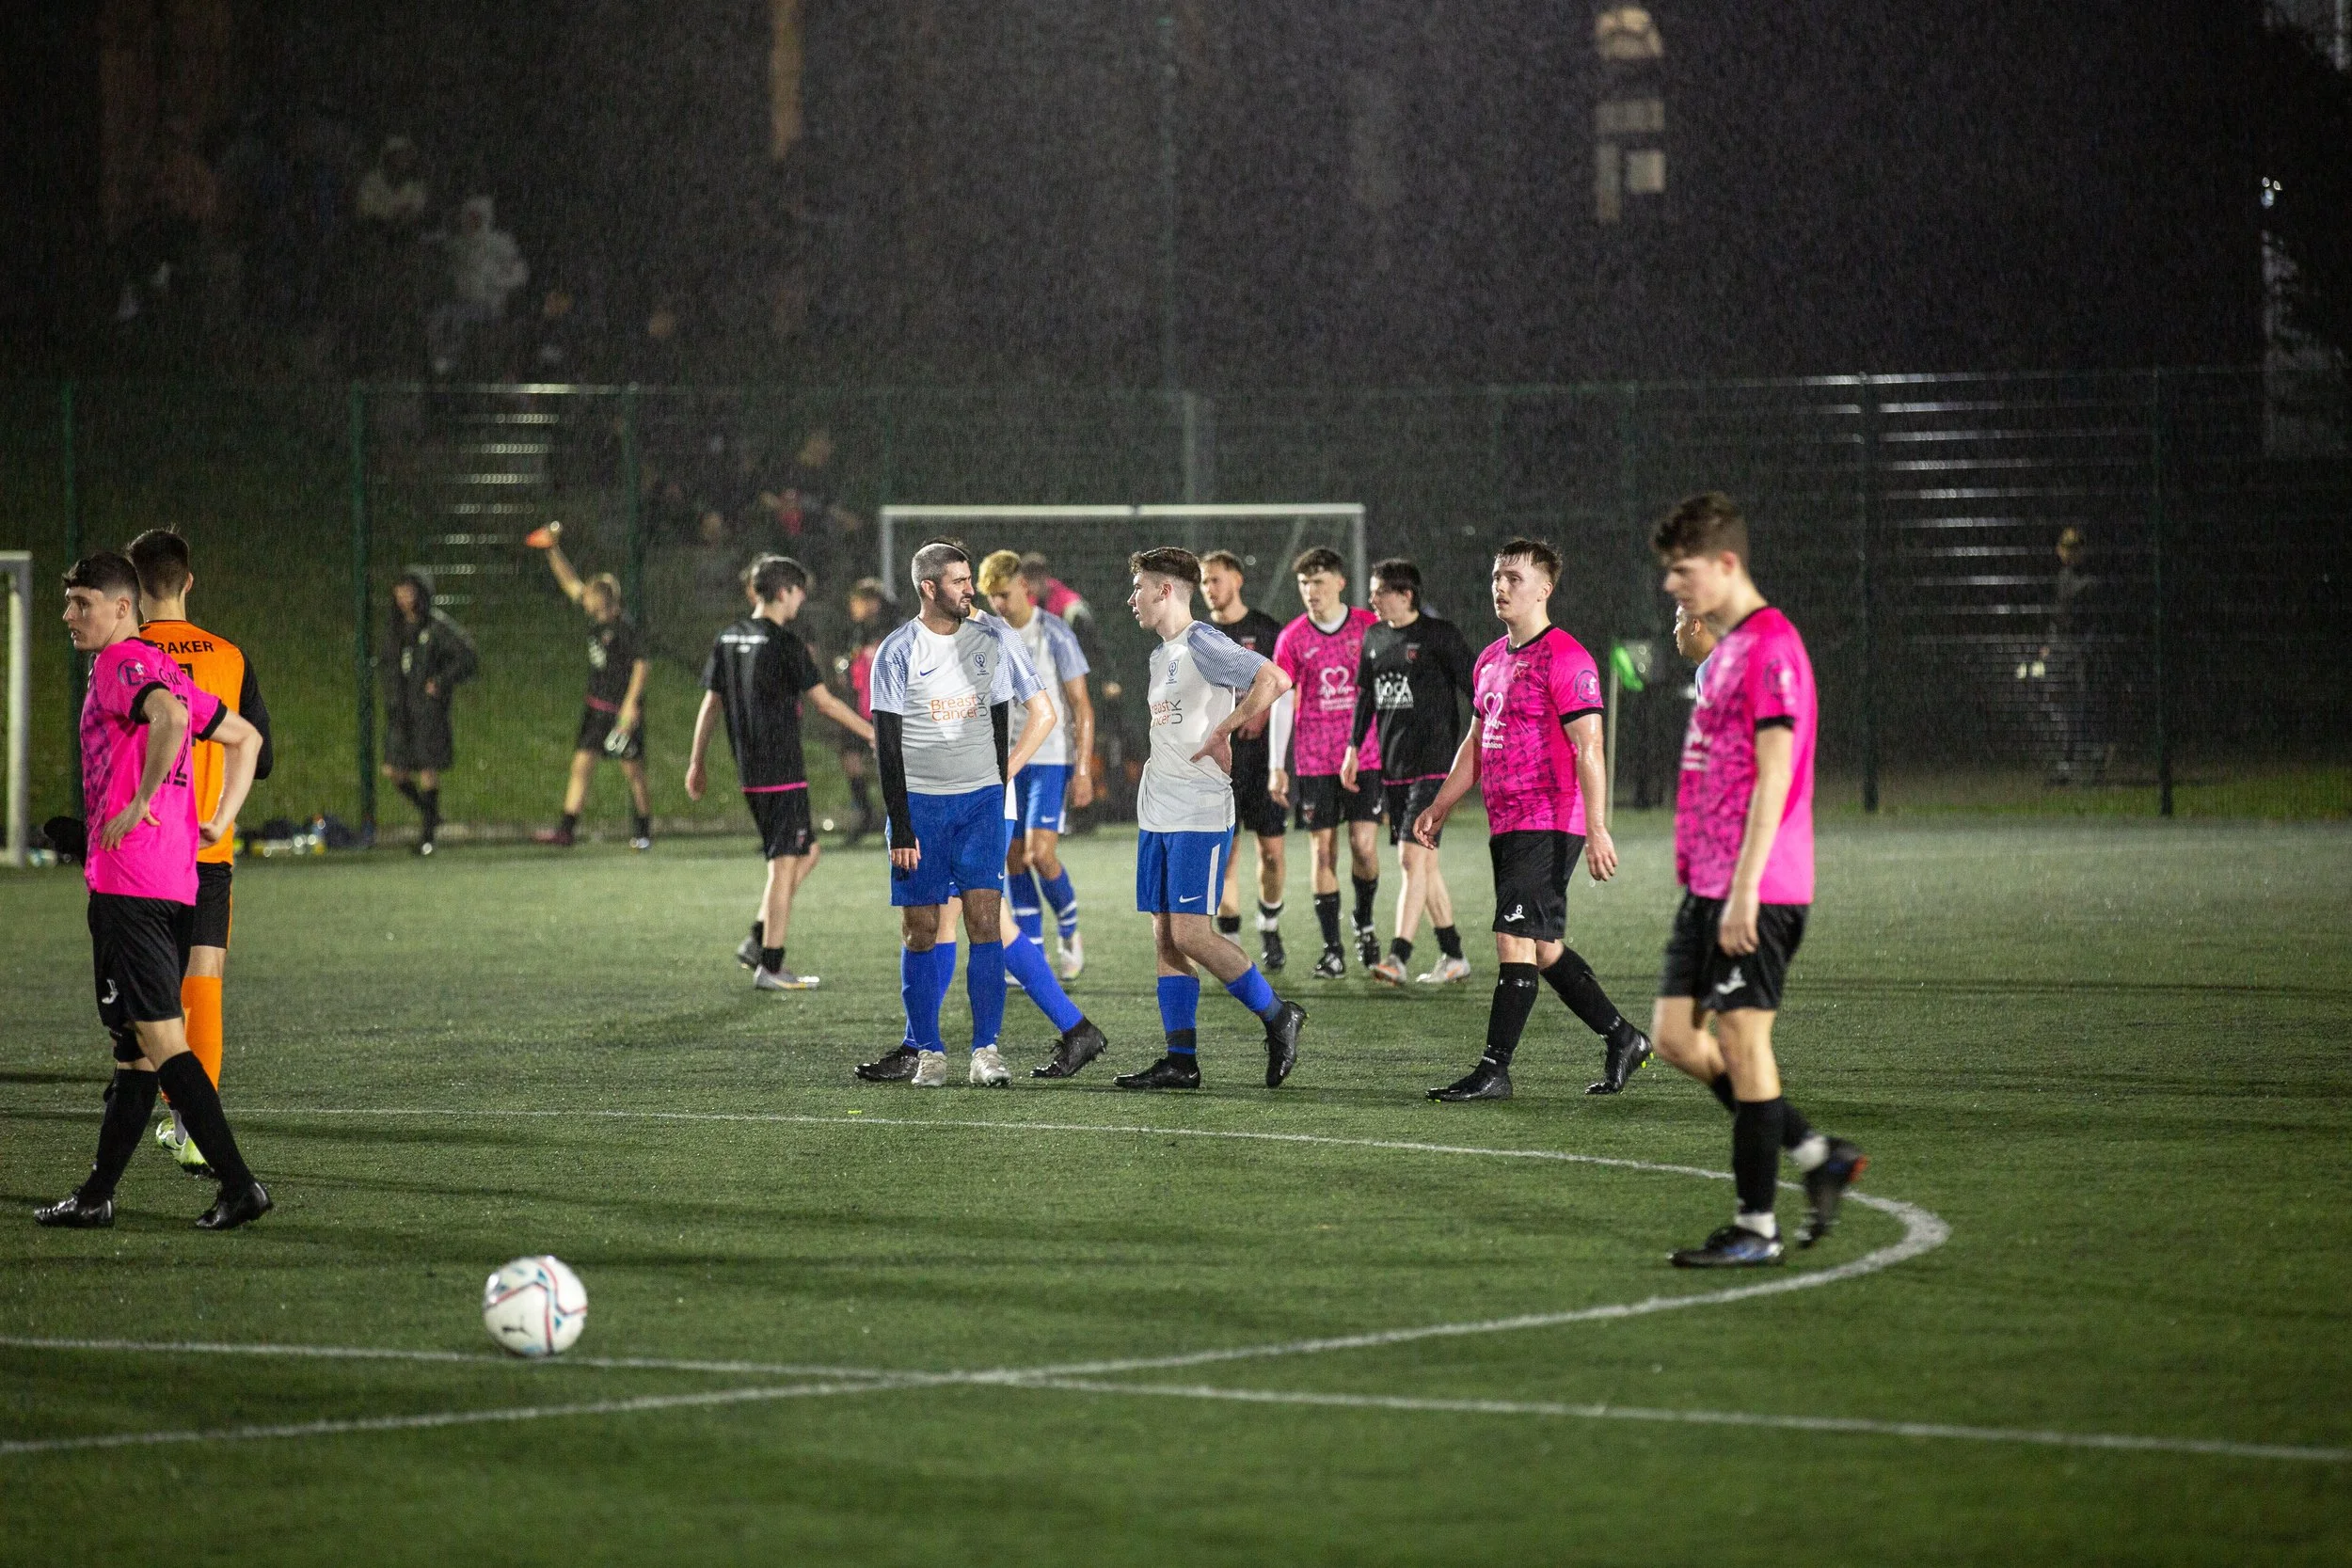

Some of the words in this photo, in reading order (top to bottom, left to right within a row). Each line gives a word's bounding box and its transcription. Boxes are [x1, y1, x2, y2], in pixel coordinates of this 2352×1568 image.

[930, 694, 977, 711] Breast
[977, 692, 989, 717] UK
[1151, 699, 1170, 715] reast
[931, 708, 978, 721] Cancer
[1169, 699, 1184, 725] UK
[1516, 904, 1523, 915] 8
